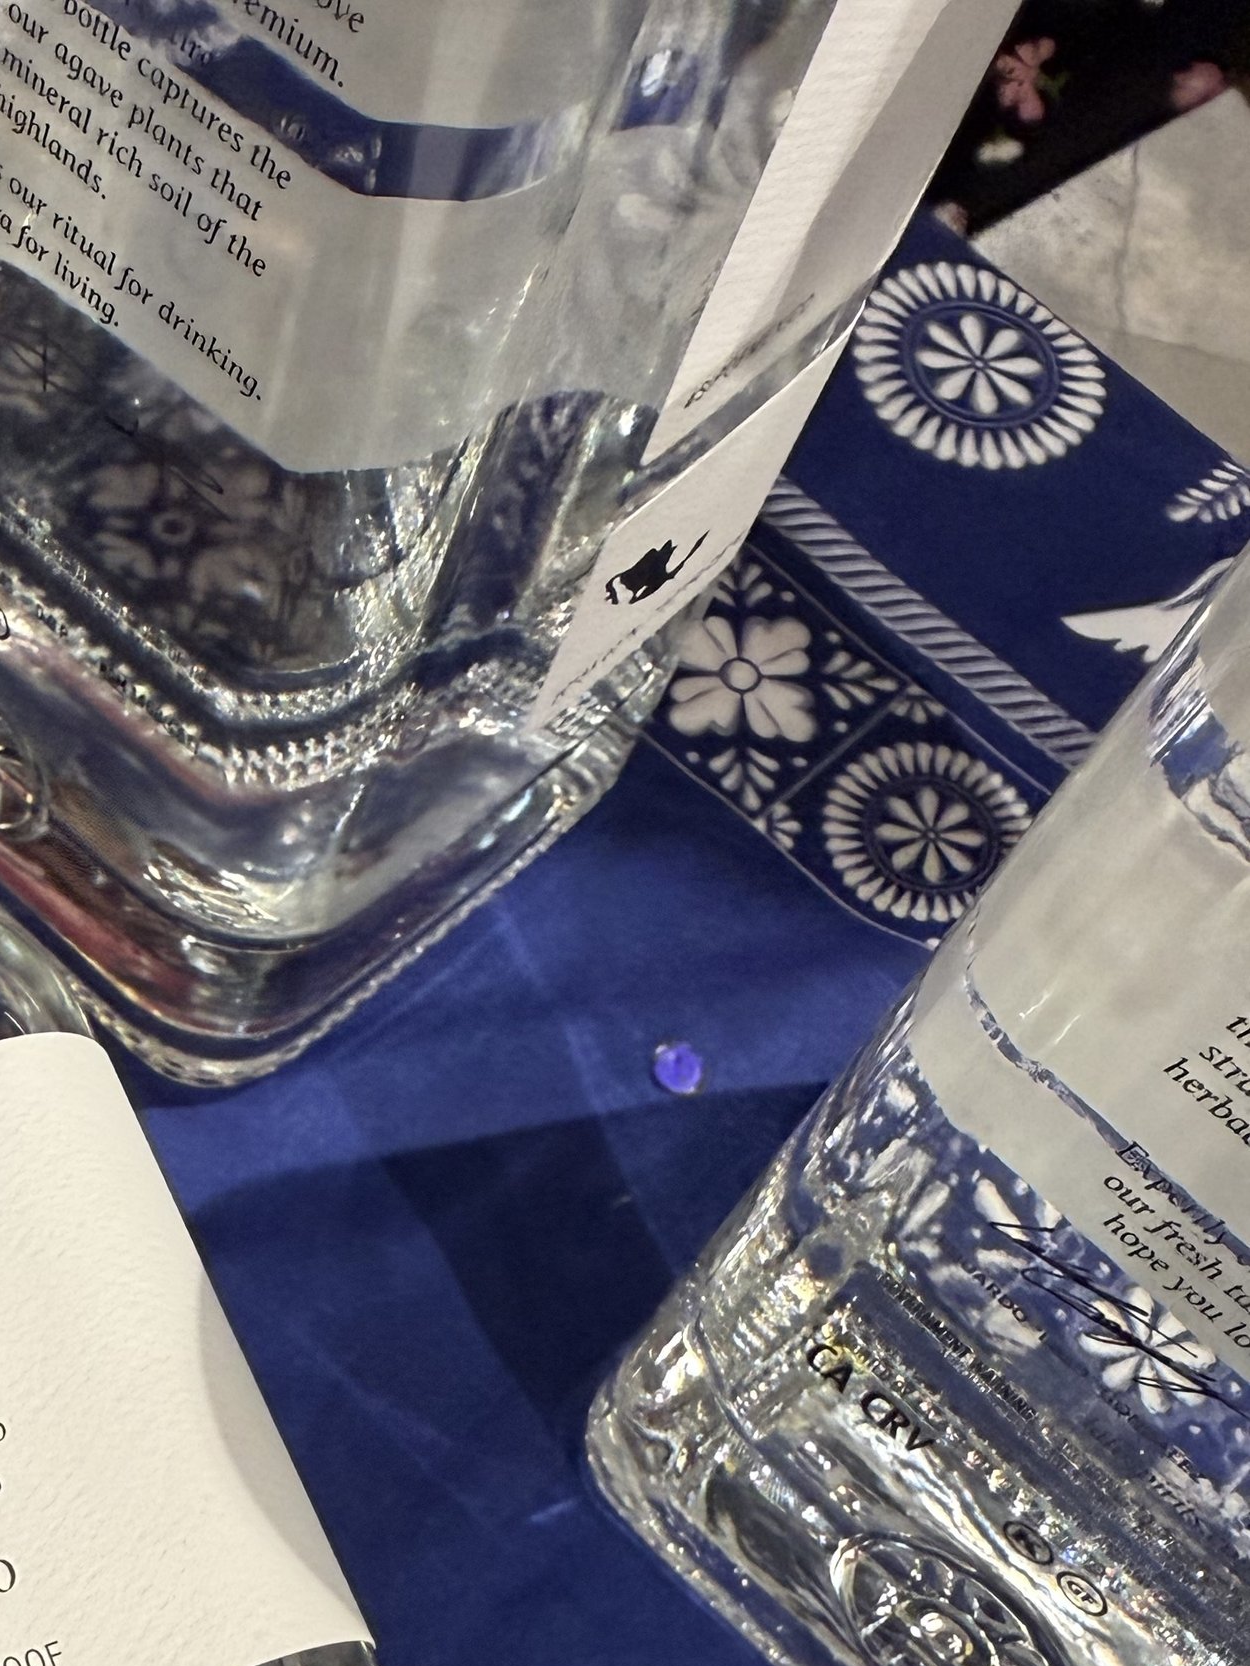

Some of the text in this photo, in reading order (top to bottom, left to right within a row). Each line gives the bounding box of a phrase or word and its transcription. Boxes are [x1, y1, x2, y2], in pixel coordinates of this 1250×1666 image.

[233, 0, 344, 88] emium.
[2, 47, 92, 134] mineral
[96, 126, 143, 178] rich
[149, 173, 193, 217] soil
[197, 213, 228, 245] of
[227, 233, 267, 277] the
[7, 3, 49, 44] our
[54, 42, 124, 108] agave
[127, 104, 205, 175] plants
[210, 168, 263, 221] that
[138, 57, 244, 152] captures
[249, 145, 292, 190] the
[8, 225, 50, 263] for
[54, 252, 119, 327] living.
[9, 176, 47, 216] our
[52, 212, 117, 276] ritual
[114, 267, 154, 305] for
[158, 301, 262, 401] drinking.
[1103, 1174, 1155, 1216] our
[1143, 1218, 1224, 1281] fresh
[1103, 1213, 1170, 1273] hope
[1162, 1276, 1224, 1324] you
[805, 1344, 936, 1452] CA CRV
